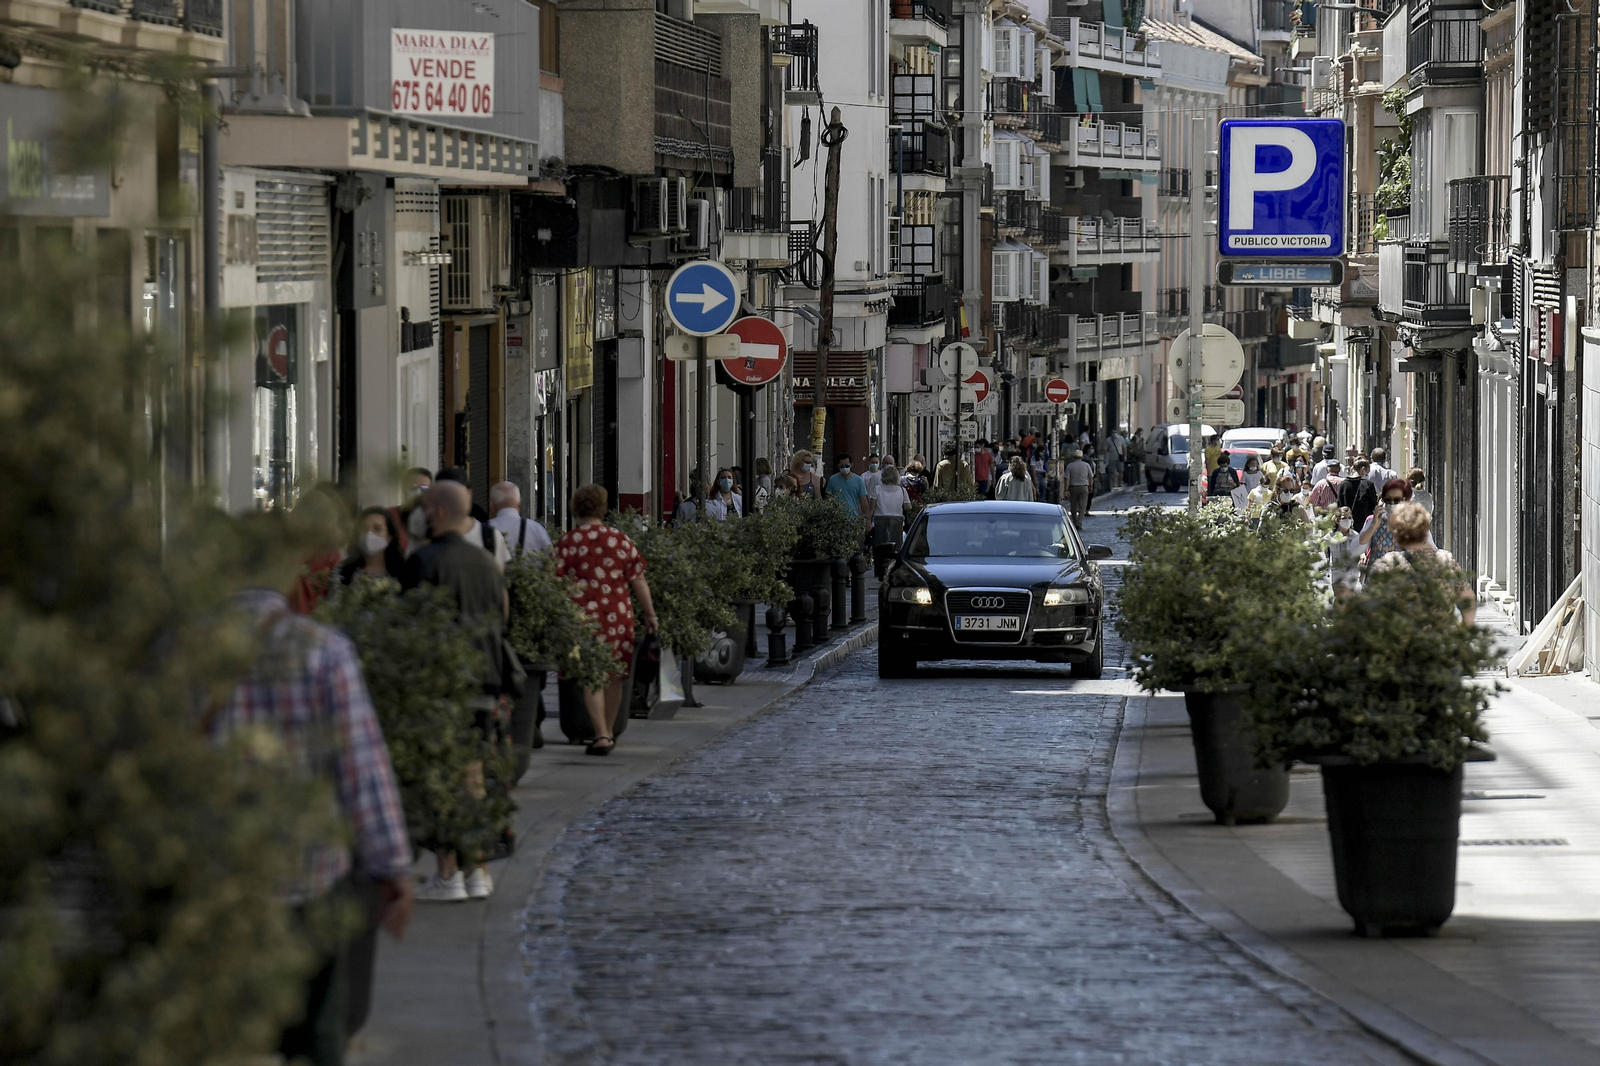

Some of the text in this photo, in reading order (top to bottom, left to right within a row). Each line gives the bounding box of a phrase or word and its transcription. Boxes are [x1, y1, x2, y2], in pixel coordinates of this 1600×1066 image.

[395, 33, 489, 50] MARIA DIAZ
[409, 57, 476, 79] VENDE
[392, 80, 491, 113] 675 64 40 06
[1229, 127, 1317, 230] P
[1234, 237, 1327, 246] PUBLICO VICTORIA
[1259, 268, 1307, 279] LIBRE
[964, 617, 1017, 629] 3731 JNM
